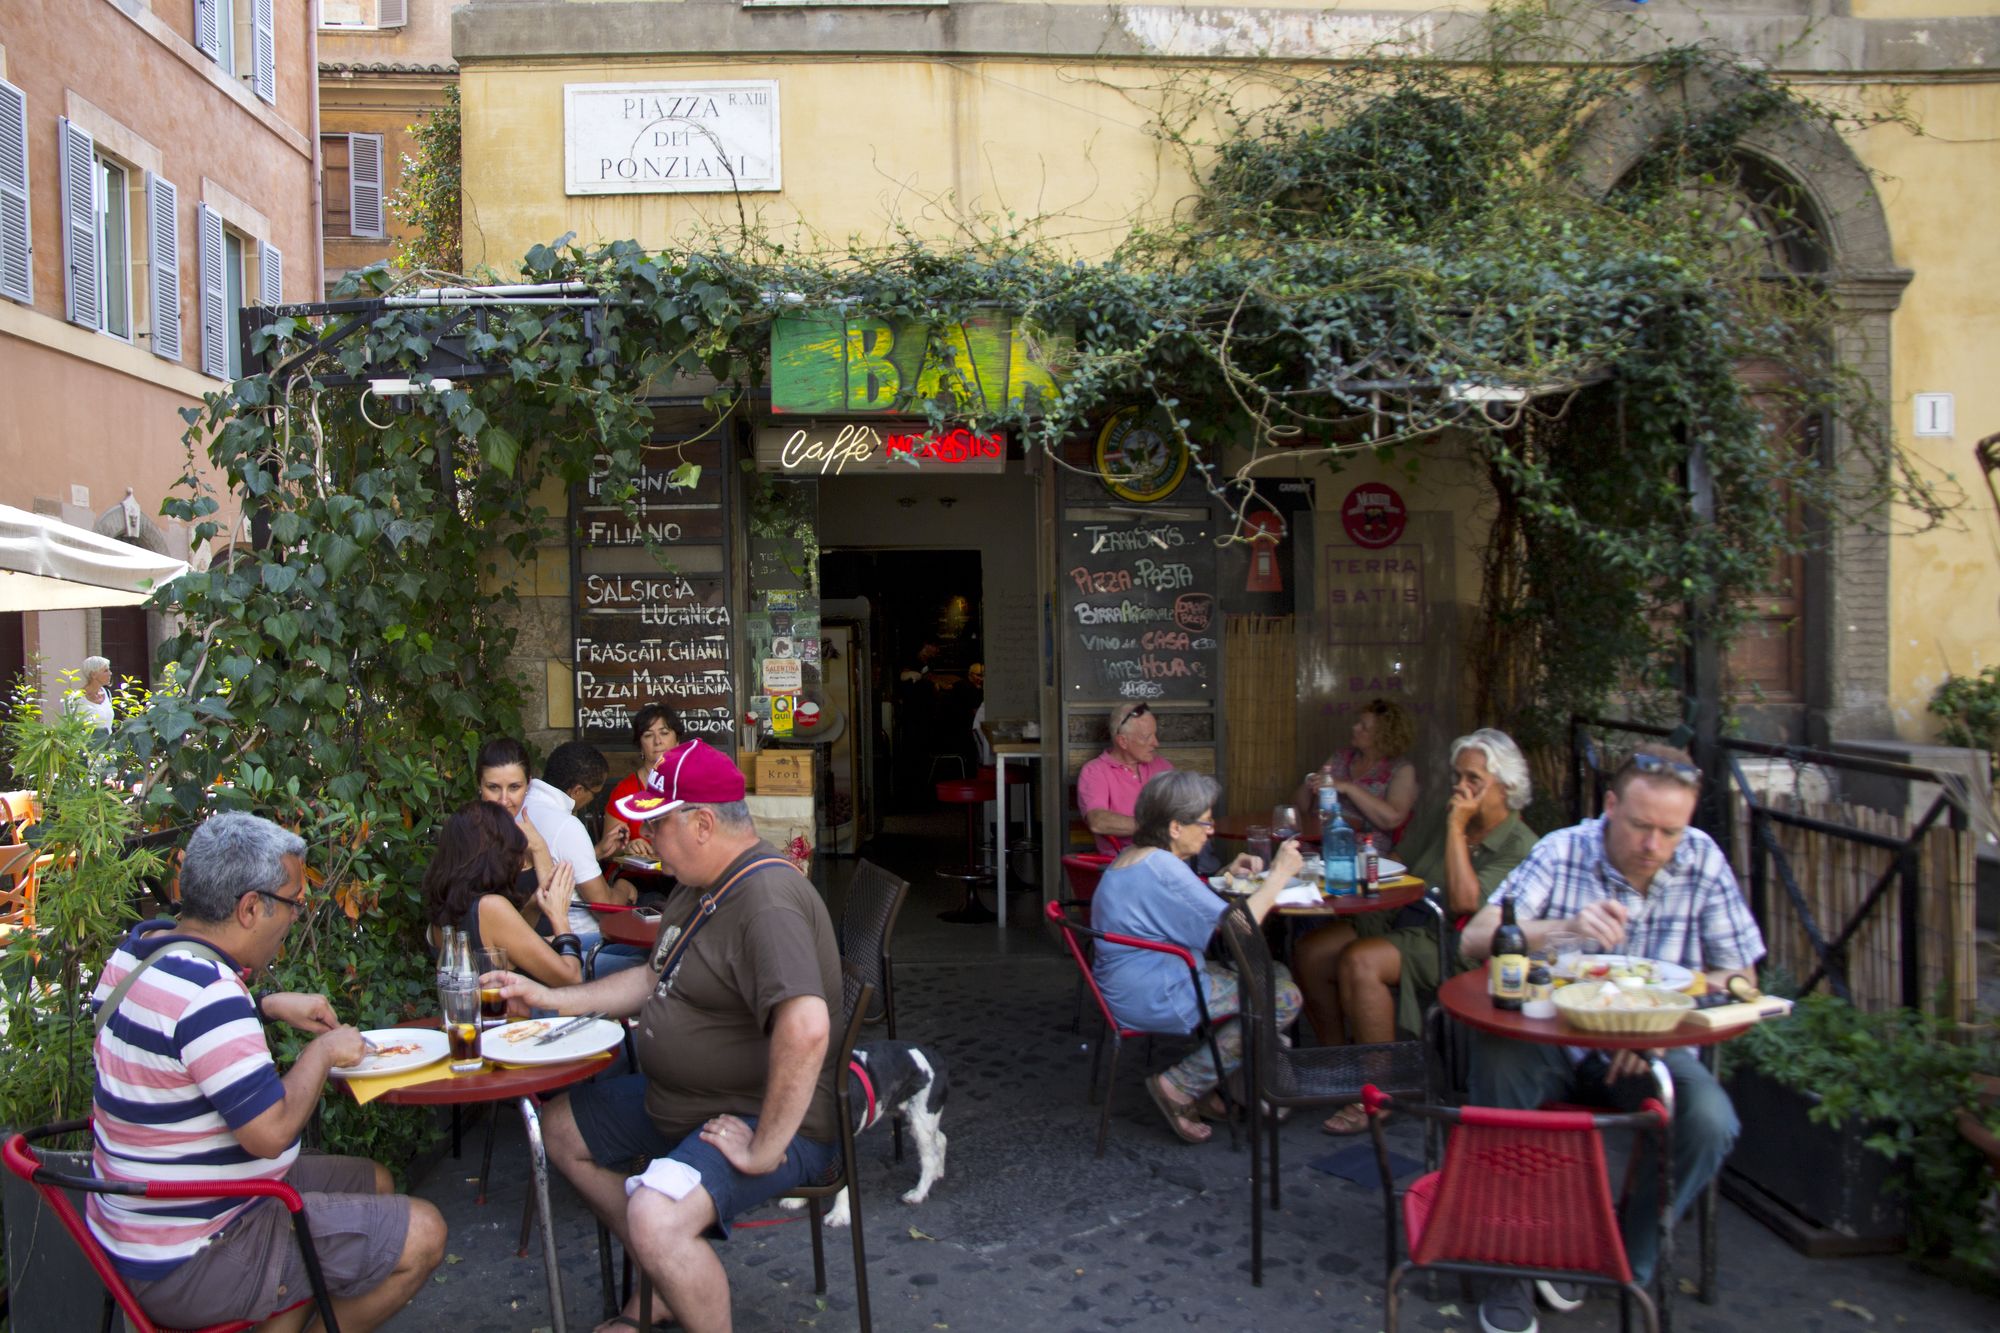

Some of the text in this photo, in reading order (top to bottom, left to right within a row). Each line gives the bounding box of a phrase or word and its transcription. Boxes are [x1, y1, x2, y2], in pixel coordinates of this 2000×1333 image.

[624, 96, 720, 119] PIAZZA
[654, 131, 690, 147] DEI
[600, 154, 745, 180] PONZIANI
[845, 316, 1062, 412] BAR
[589, 521, 681, 545] FILIANO
[1332, 559, 1417, 573] TERRA
[1070, 567, 1132, 595] PIZZA
[1332, 588, 1419, 604] SATIS
[1141, 630, 1190, 650] CASA
[1140, 653, 1191, 679] HOUR
[578, 703, 633, 730] PASTA
